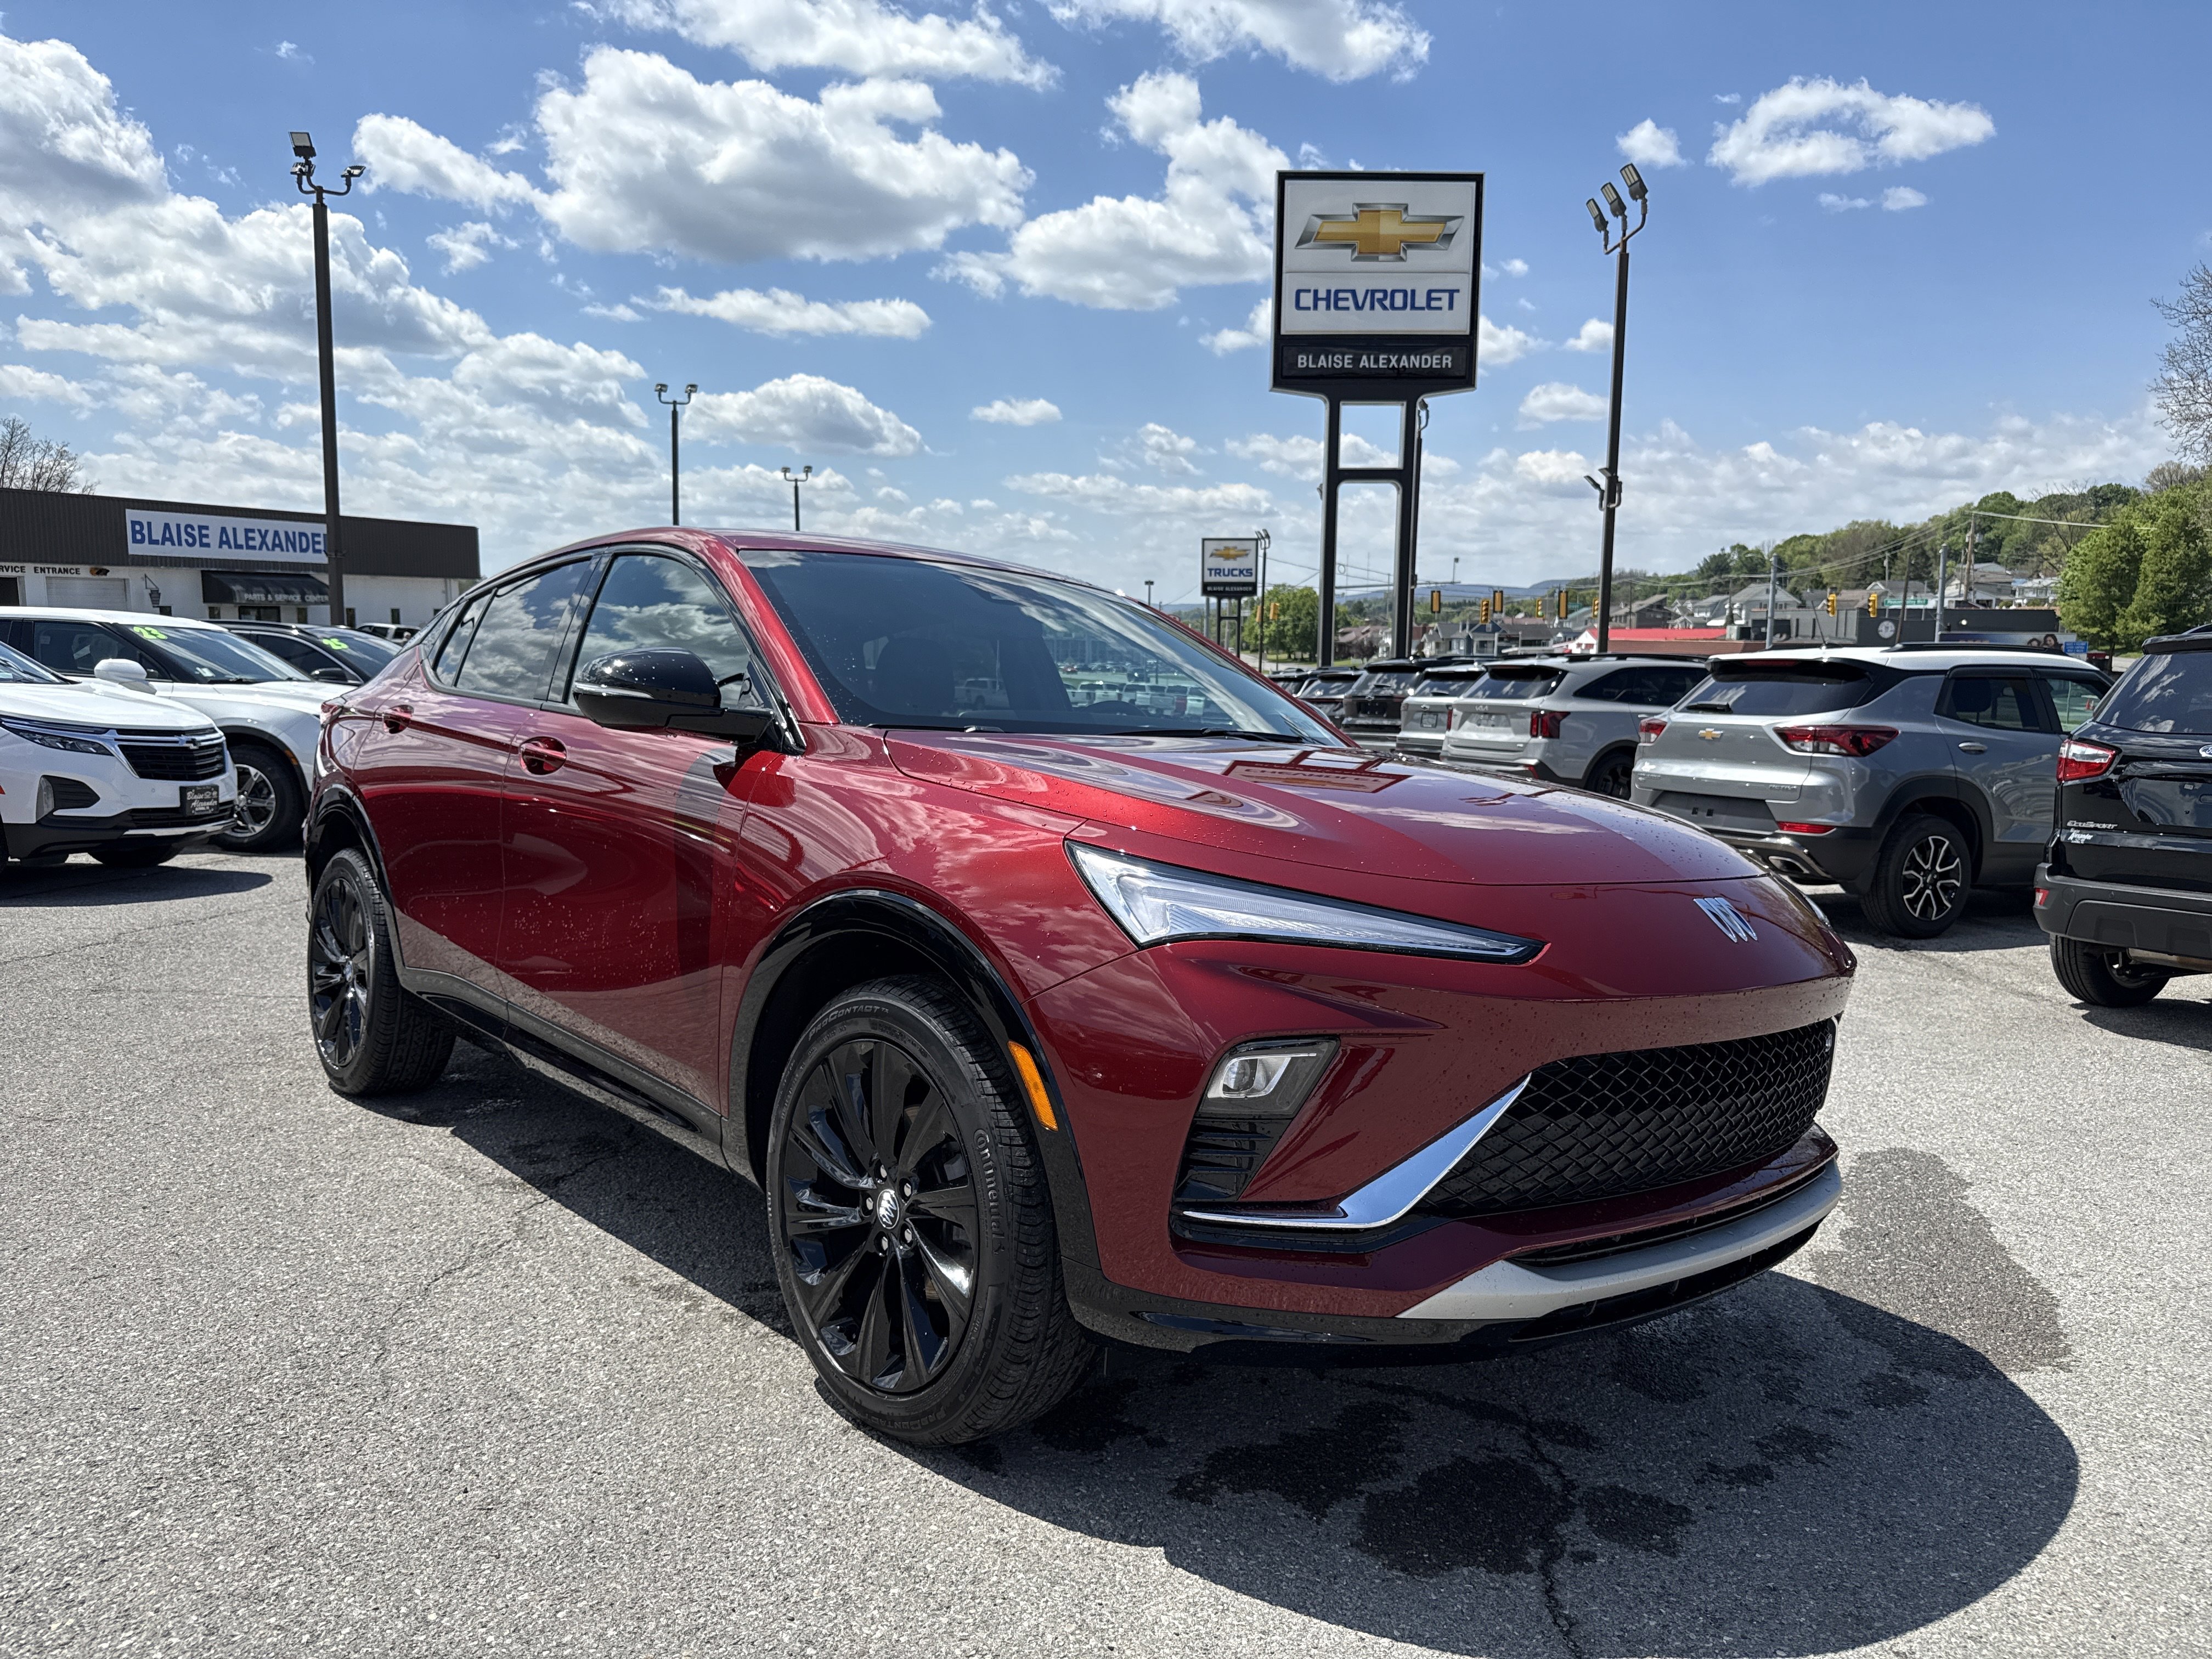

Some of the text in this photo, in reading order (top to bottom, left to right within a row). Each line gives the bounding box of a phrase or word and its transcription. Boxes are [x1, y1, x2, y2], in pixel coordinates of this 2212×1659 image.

[1294, 289, 1460, 311] CHEVROLET
[1297, 354, 1452, 369] BLAISE ALEXANDER
[131, 520, 211, 548] BLAISE
[33, 566, 81, 575] ENTRANCE
[1207, 568, 1253, 577] TRUCKS
[133, 626, 168, 640] 23
[973, 1128, 1006, 1239] Continental
